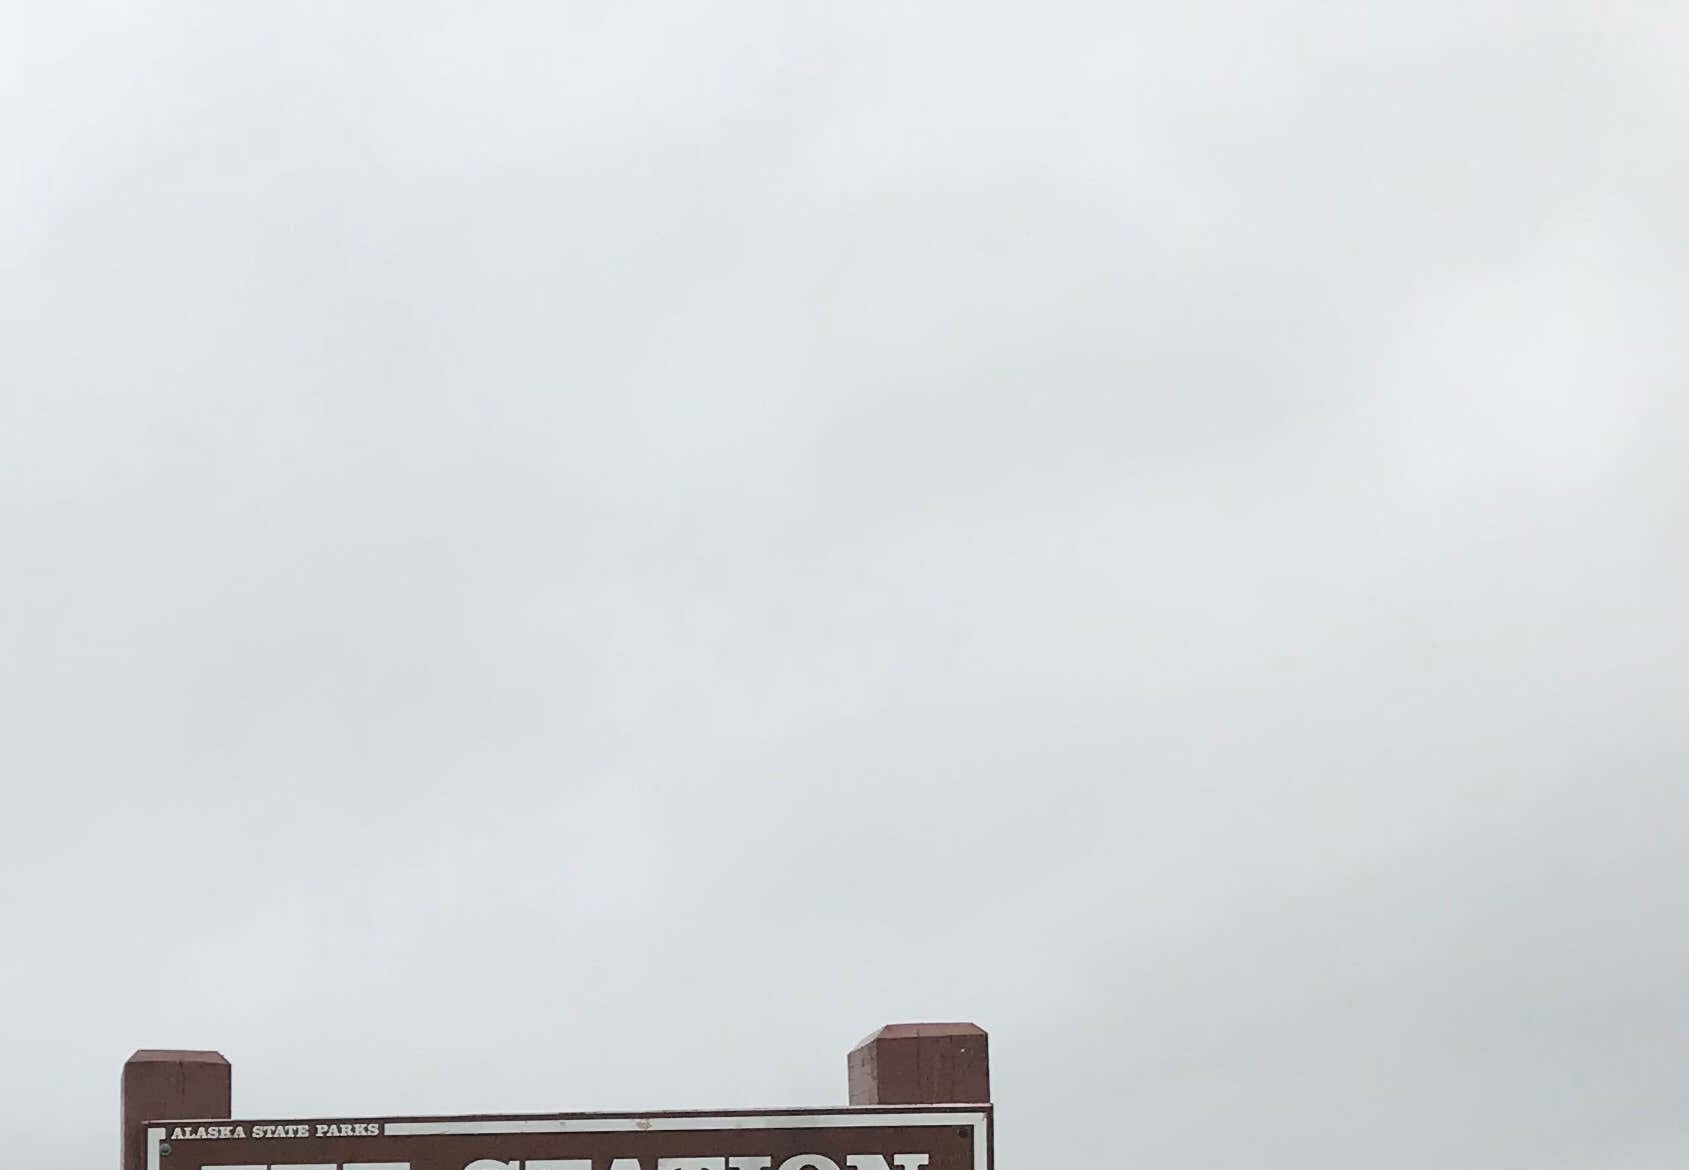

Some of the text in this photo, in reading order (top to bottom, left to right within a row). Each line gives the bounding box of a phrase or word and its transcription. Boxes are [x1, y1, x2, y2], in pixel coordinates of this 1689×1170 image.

[171, 1124, 379, 1139] ALASKA STATE PARKS
